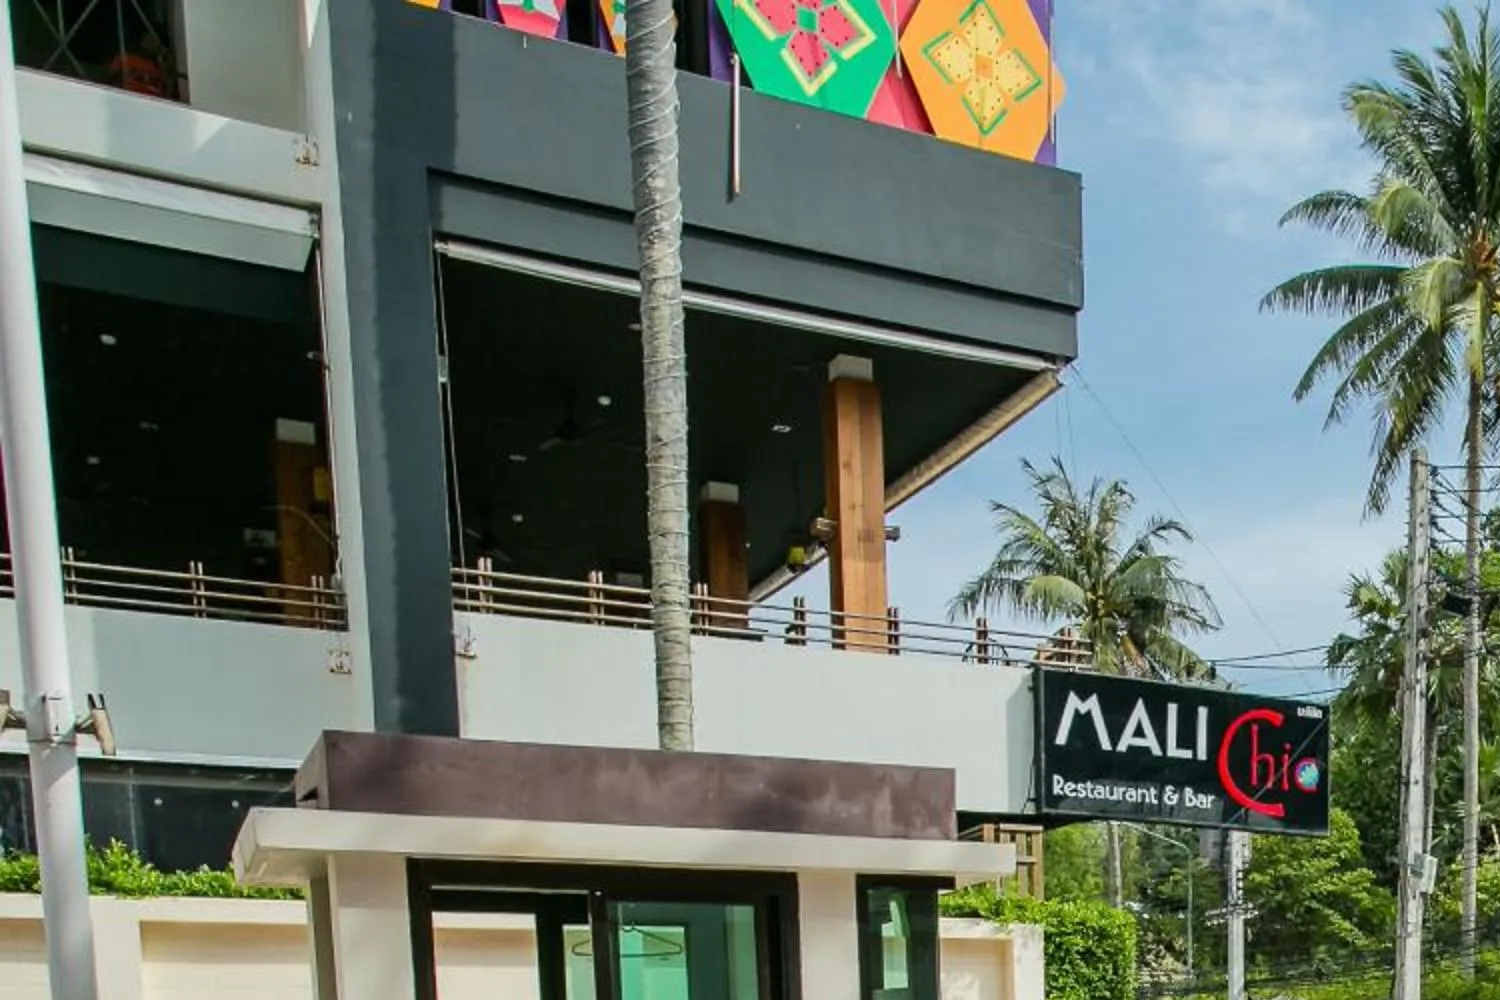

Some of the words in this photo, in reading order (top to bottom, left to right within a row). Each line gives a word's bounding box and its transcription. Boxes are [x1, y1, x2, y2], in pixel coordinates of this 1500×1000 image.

[1055, 690, 1208, 760] MALI
[1053, 774, 1158, 805] Restaurant
[1164, 785, 1178, 806] &
[1185, 788, 1216, 809] Bar
